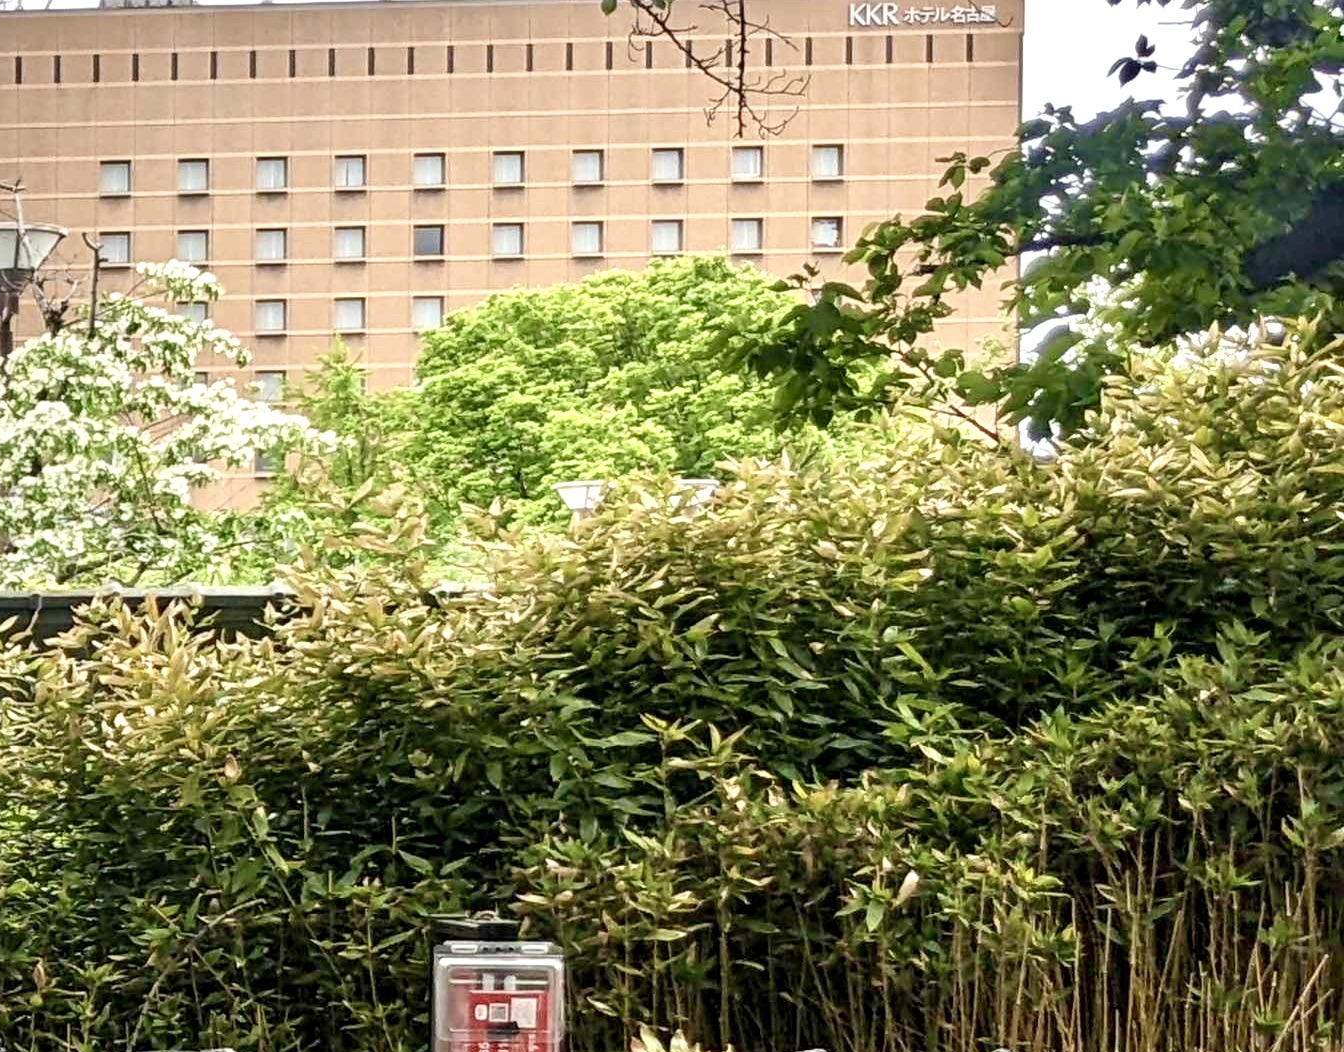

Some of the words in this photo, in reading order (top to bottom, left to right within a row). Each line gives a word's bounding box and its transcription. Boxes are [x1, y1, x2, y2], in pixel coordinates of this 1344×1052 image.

[849, 3, 899, 26] KKR
[903, 5, 997, 23] ホテル名古屋
